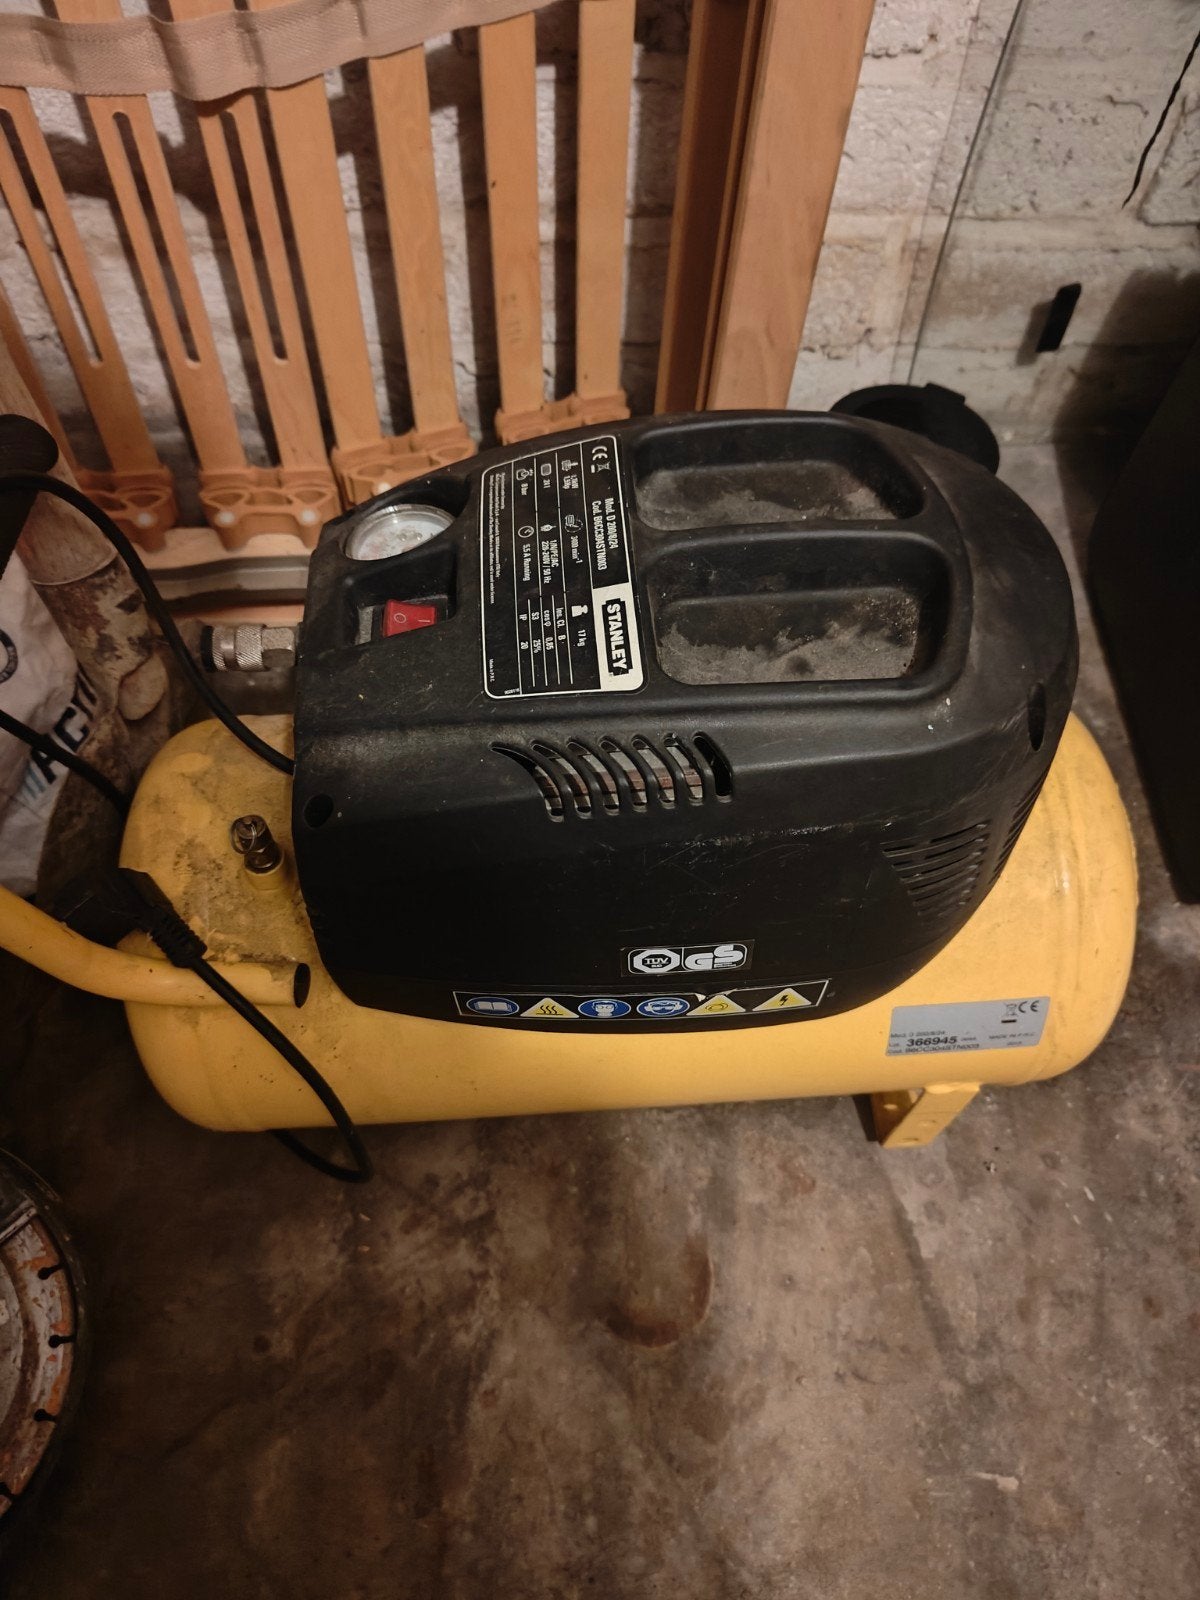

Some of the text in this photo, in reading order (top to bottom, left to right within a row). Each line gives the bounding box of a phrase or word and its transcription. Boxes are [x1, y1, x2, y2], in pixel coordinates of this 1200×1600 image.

[592, 501, 602, 515] Cod.
[604, 498, 614, 515] Mod.
[607, 522, 618, 549] 200/8/24
[522, 558, 531, 581] Running
[544, 576, 551, 584] Hz
[532, 612, 541, 653] S3 25%
[606, 604, 627, 669] STANLEY
[521, 641, 528, 649] 20
[577, 638, 586, 647] kg
[685, 945, 744, 970] GS
[906, 1036, 958, 1047] 366945
